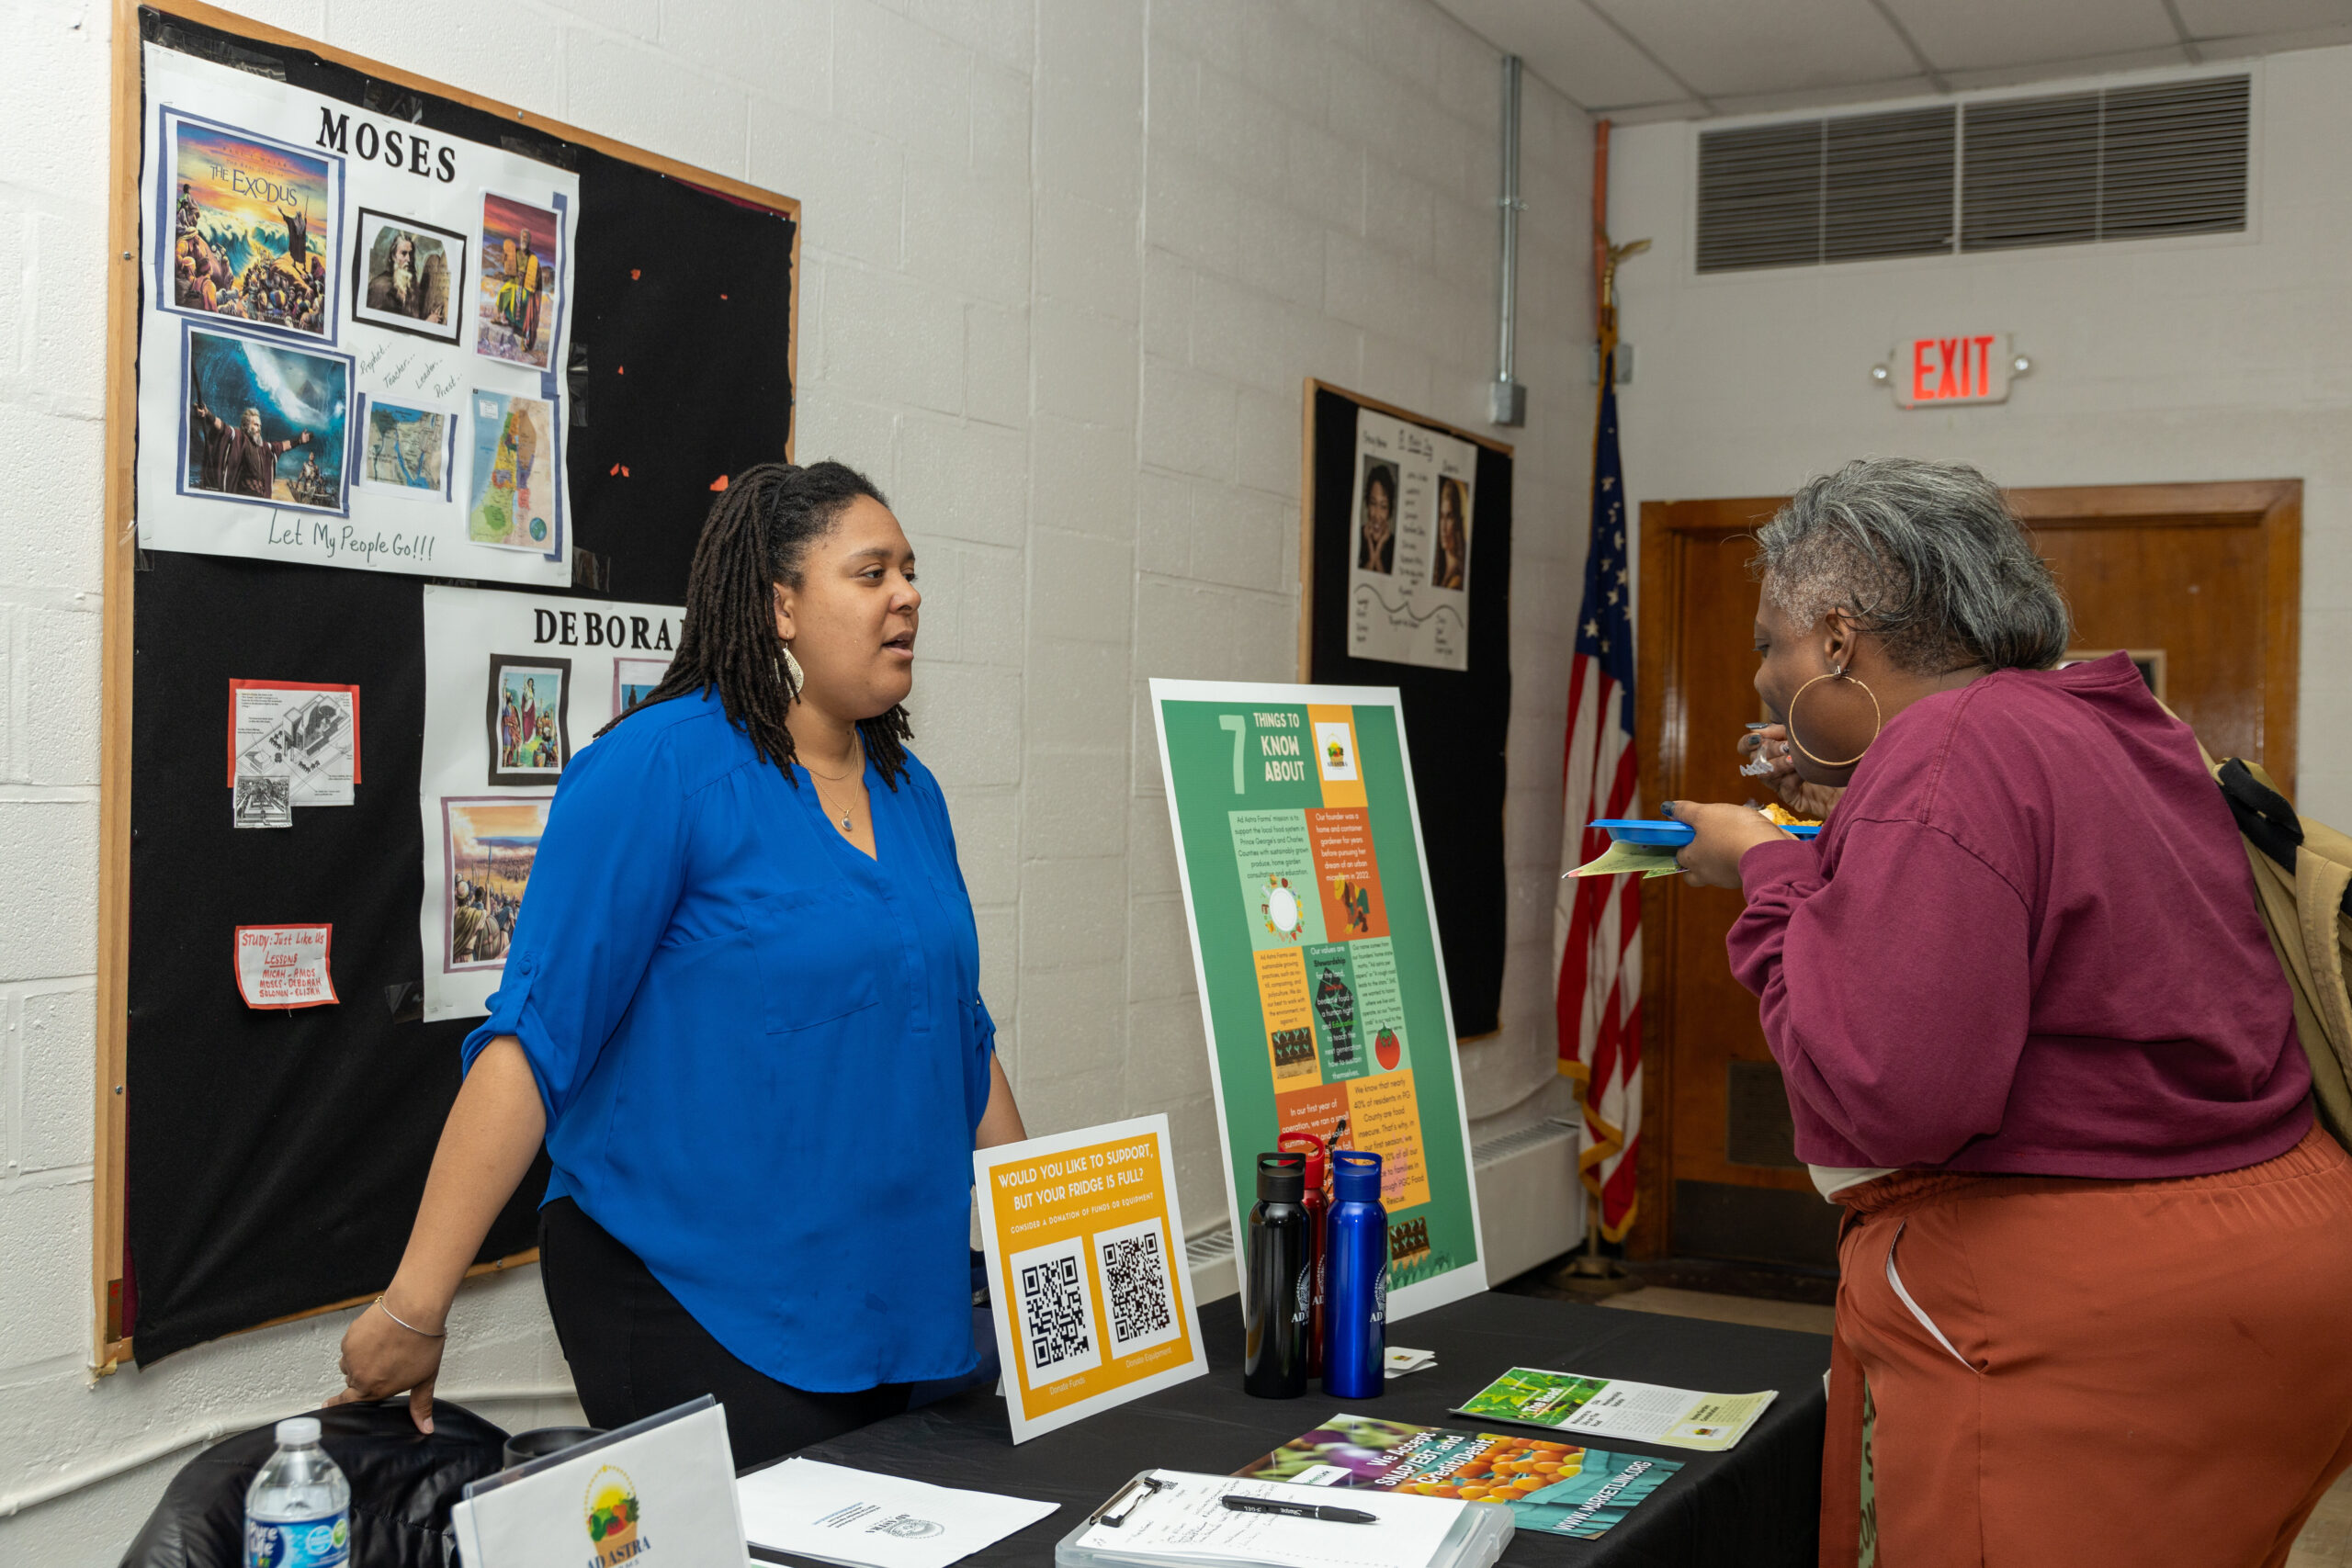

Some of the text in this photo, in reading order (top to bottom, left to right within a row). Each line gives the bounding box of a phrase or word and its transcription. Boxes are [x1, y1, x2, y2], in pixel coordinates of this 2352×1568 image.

[316, 107, 455, 183] MOSES
[210, 162, 297, 207] THE EXODUS
[1914, 335, 1995, 400] EXIT
[268, 508, 435, 563] Let My People Go!!!
[534, 609, 684, 651] DEBORA
[1253, 713, 1300, 728] THINGS TO
[1219, 715, 1246, 795] 7
[1261, 736, 1300, 756] KNOW
[1265, 761, 1305, 781] ABOUT
[1330, 824, 1340, 832] and
[243, 931, 323, 953] STUDY: Just Like Us
[1321, 945, 1337, 953] values
[1337, 945, 1345, 953] are
[1314, 957, 1346, 967] Stewardship
[260, 977, 322, 988] MOSES DEBORAH
[263, 968, 315, 978] MICAH AMOS
[259, 987, 320, 998] SOLOMON ELIJAH
[1354, 1078, 1406, 1094] We know that nearly
[1290, 1099, 1338, 1116] In our first year of
[1354, 1100, 1365, 1109] 40%
[1367, 1099, 1373, 1107] of
[1374, 1095, 1396, 1106] residents
[1402, 1090, 1410, 1100] PG
[1282, 1121, 1310, 1134] operation,
[1311, 1118, 1319, 1127] we
[1320, 1117, 1329, 1125] ran
[1335, 1111, 1349, 1122] small
[1363, 1107, 1405, 1122] County are food
[1320, 1133, 1331, 1142] and
[1358, 1127, 1381, 1138] insecure.
[1382, 1123, 1396, 1133] That's
[1397, 1121, 1408, 1130] why,
[1364, 1144, 1373, 1152] our
[1374, 1140, 1385, 1150] first
[1385, 1153, 1396, 1162] 10%
[1396, 1149, 1402, 1159] of
[1409, 1148, 1418, 1156] our
[998, 1144, 1154, 1189] WOULD YOU LIKE TO SUPPORT,
[1413, 1162, 1419, 1170] in
[1013, 1168, 1144, 1211] BUT YOUR FRIDGE IS FULL?
[1398, 1175, 1424, 1187] PGC Food
[1049, 1210, 1080, 1224] DONATION
[1082, 1208, 1090, 1216] OF
[1091, 1203, 1110, 1214] FUNDS
[1112, 1201, 1120, 1209] OR
[1122, 1191, 1154, 1206] EQUIPMENT
[1292, 1312, 1305, 1323] AD
[1370, 1312, 1383, 1323] AD
[1126, 1347, 1172, 1368] Donate Equipment
[1049, 1377, 1086, 1395] Donate Funds
[1521, 1388, 1563, 1412] The Road
[1366, 1431, 1437, 1467] We Accept
[1374, 1435, 1465, 1487] SNAP/EBT and
[1416, 1438, 1496, 1484] Credit/Debit
[1553, 1461, 1653, 1530] WWW.MARKETLINK.ORG
[250, 1521, 277, 1540] Pure
[250, 1540, 275, 1557] Life
[610, 1536, 650, 1564] ASTRA
